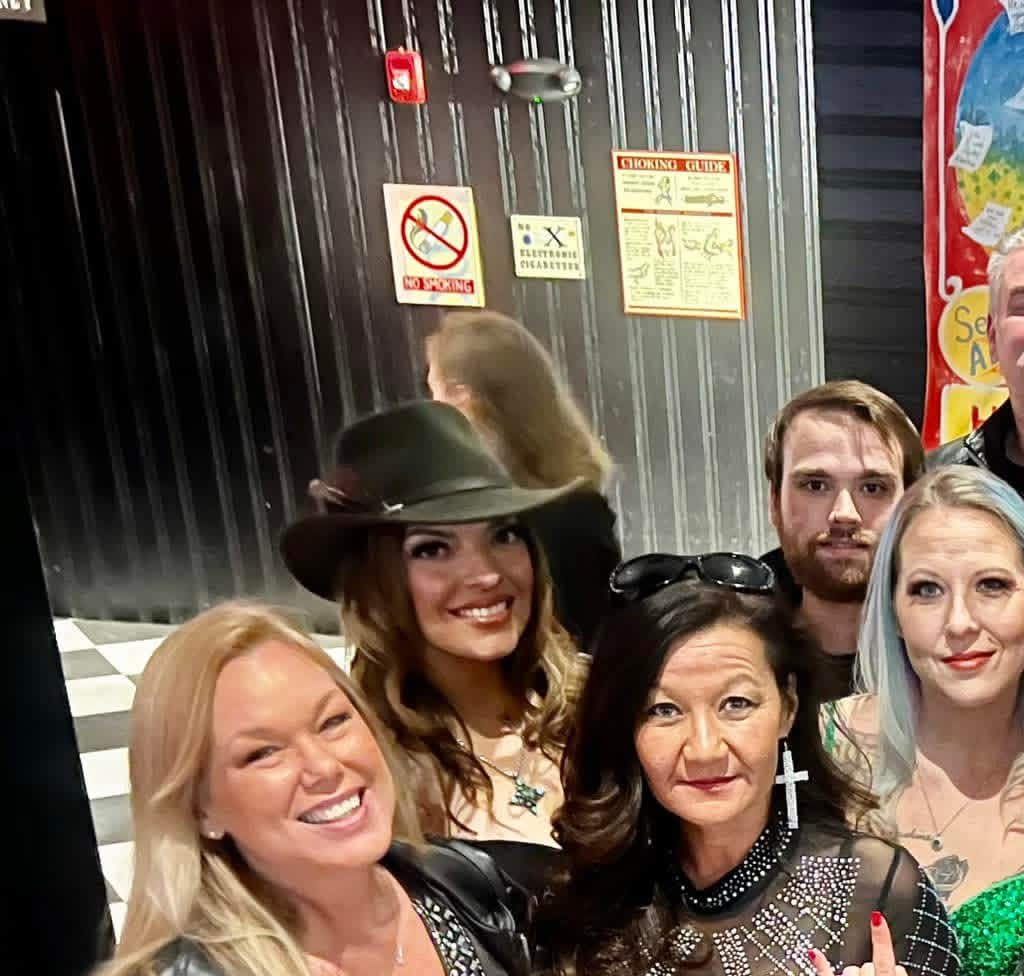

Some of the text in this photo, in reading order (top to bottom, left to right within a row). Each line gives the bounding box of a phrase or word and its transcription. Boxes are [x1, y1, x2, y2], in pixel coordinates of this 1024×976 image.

[621, 158, 727, 172] CHOKING GUIDE
[404, 276, 473, 293] NO SMOKING
